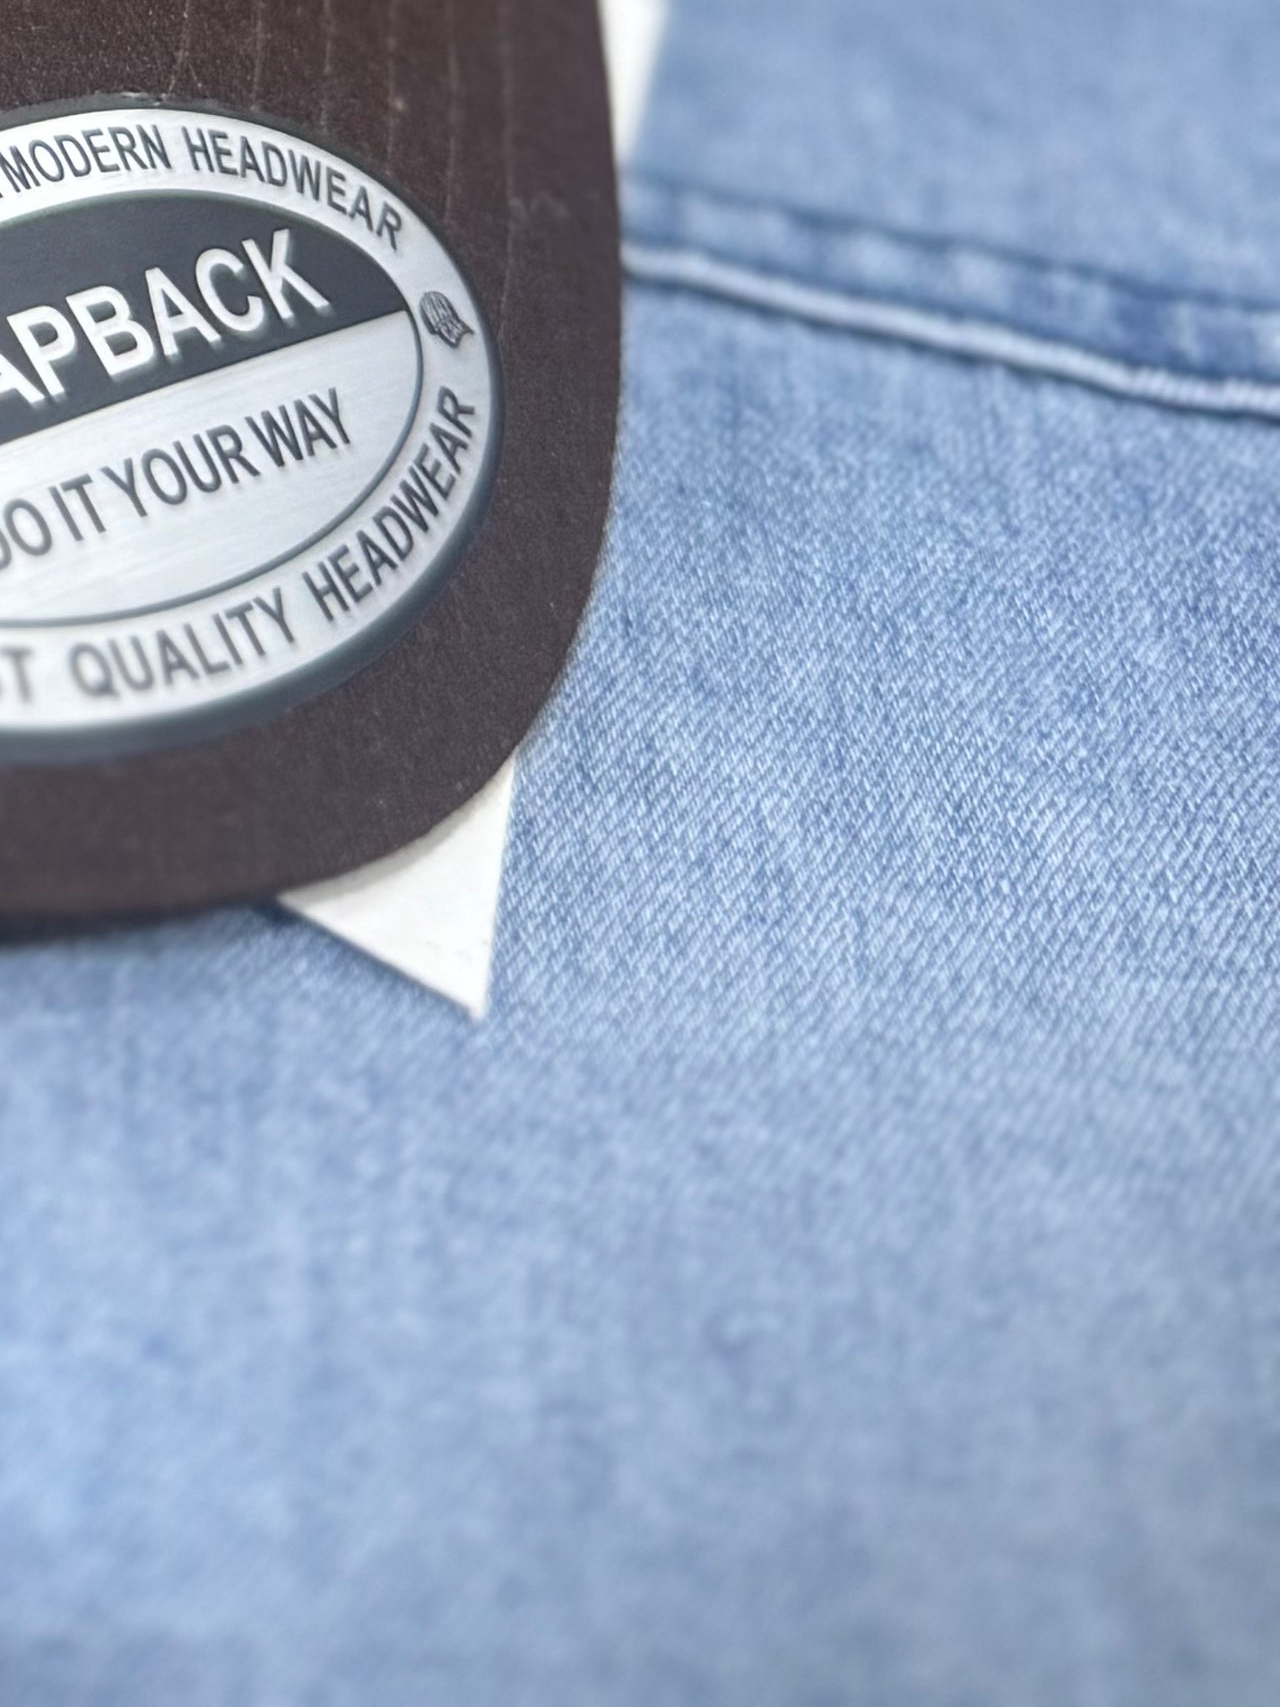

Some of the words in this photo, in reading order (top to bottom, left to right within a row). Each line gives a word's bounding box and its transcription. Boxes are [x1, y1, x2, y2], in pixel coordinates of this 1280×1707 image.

[182, 126, 404, 251] HEADWEAR
[51, 473, 110, 544] IT
[102, 424, 262, 519] YOUR
[245, 386, 352, 469] WAY
[68, 587, 296, 700] QUALITY
[301, 385, 477, 623] HEADWEAR
